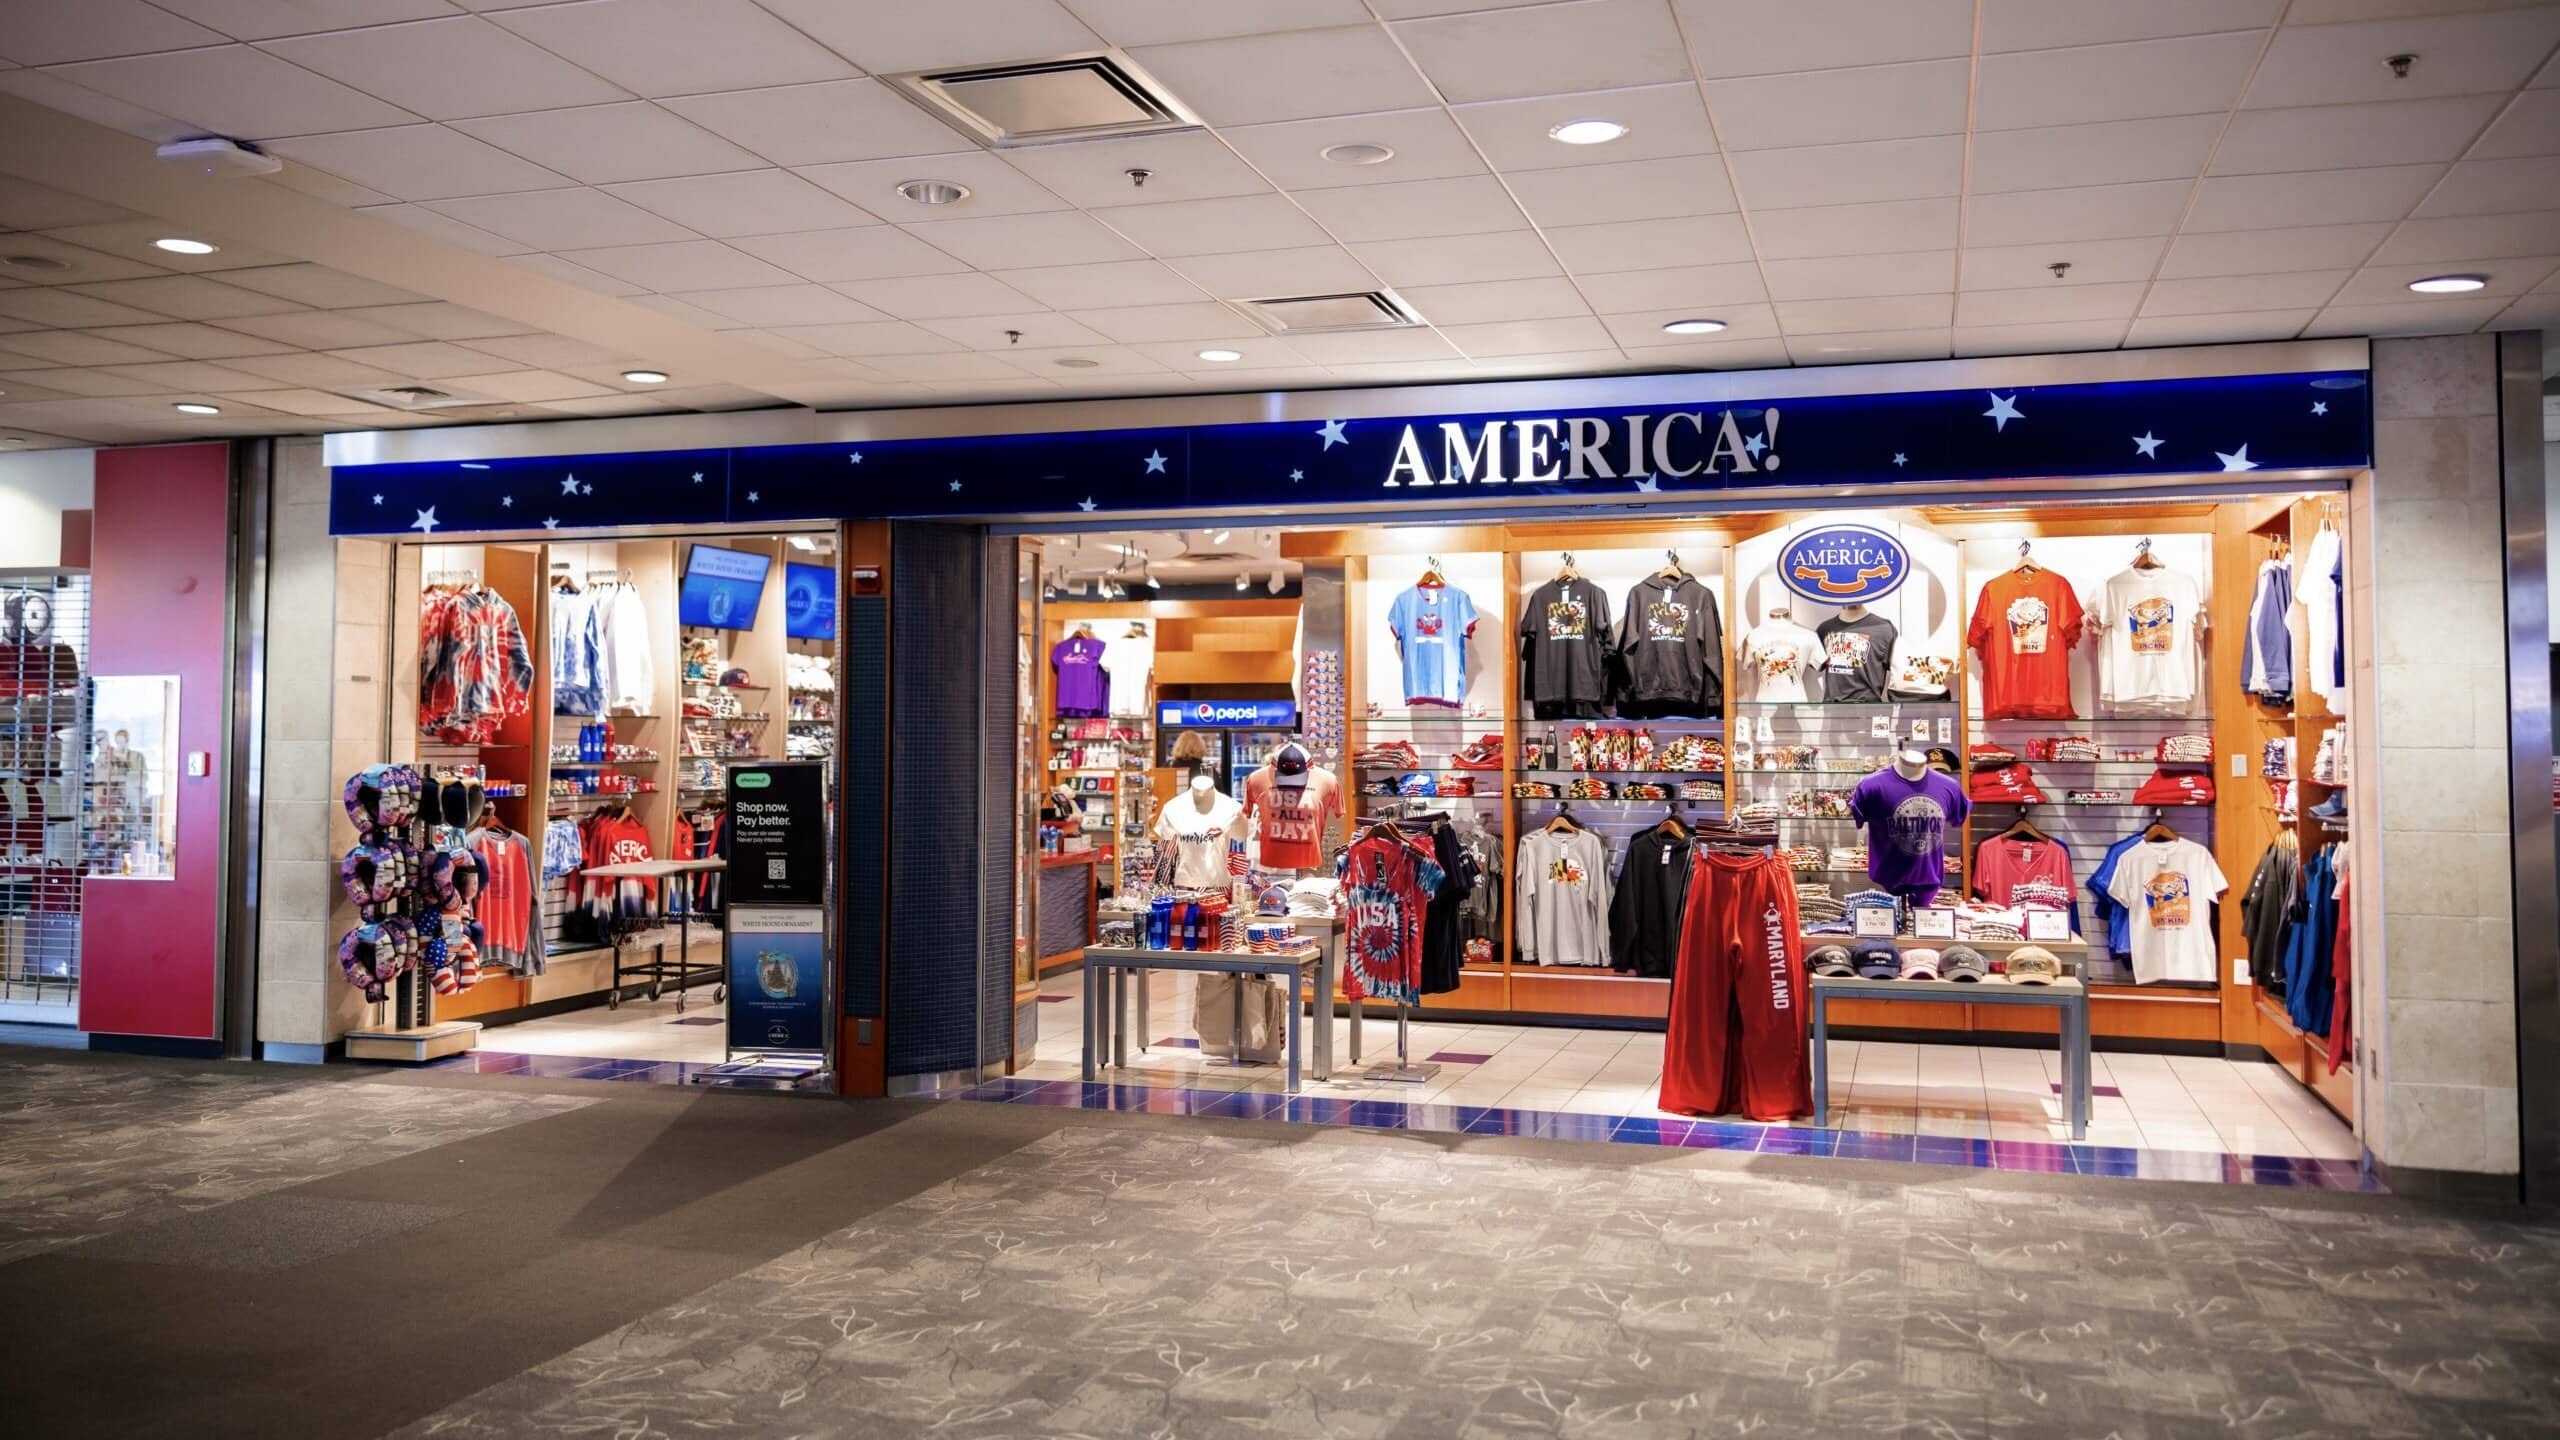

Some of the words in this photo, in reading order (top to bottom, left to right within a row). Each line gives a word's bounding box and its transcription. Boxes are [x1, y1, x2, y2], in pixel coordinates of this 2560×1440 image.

[1383, 407, 1780, 487] AMERICA!
[1792, 548, 1894, 566] AMERICA!
[1216, 705, 1258, 721] pepsi
[736, 802, 764, 815] Shop
[765, 803, 789, 813] now.
[1270, 790, 1315, 809] USA
[736, 815, 757, 828] Pay
[758, 815, 791, 826] better.
[1279, 809, 1305, 821] ALL
[1270, 821, 1312, 840] DAY
[1357, 901, 1399, 929] USA
[1766, 925, 1790, 1010] MARYLAND
